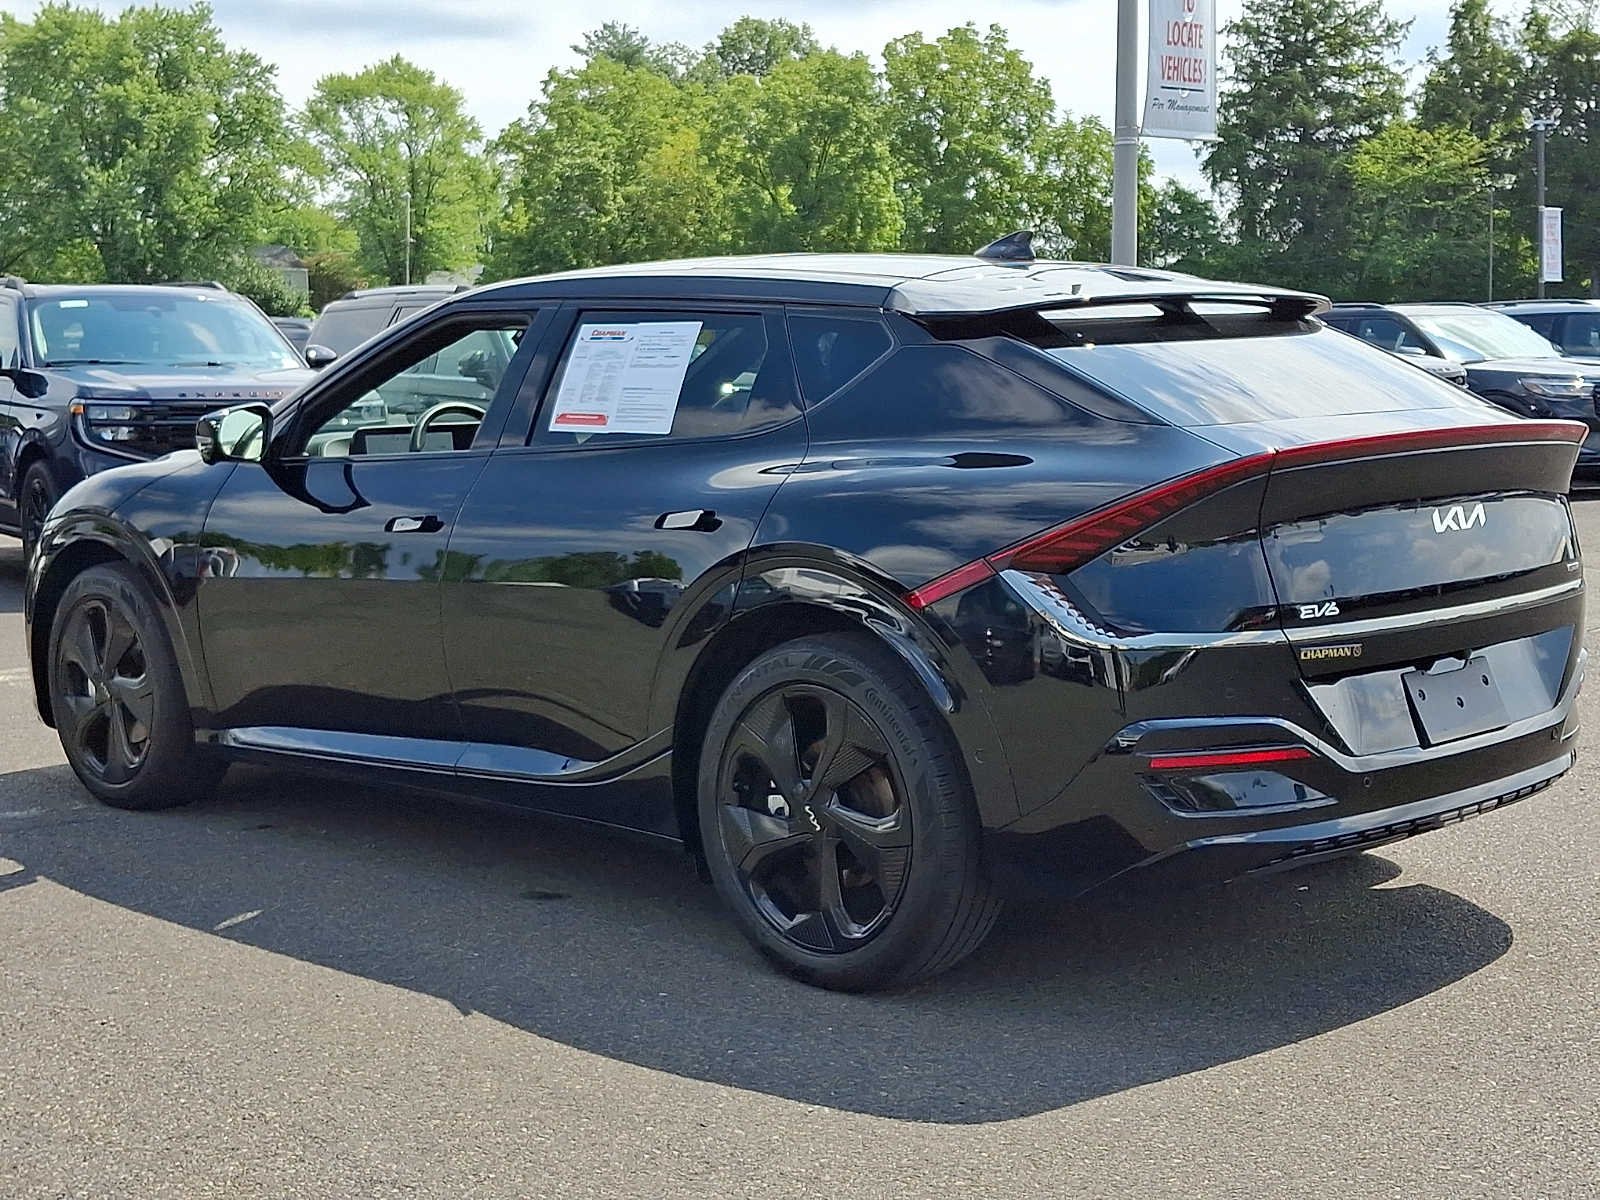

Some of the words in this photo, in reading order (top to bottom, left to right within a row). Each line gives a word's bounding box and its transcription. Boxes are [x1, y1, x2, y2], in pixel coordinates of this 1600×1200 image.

[1166, 21, 1204, 49] LOCATE
[1160, 55, 1207, 84] VEHICLES!
[1151, 97, 1165, 111] Per
[1167, 98, 1210, 115] Management
[1432, 503, 1487, 534] KIA
[1299, 601, 1340, 620] EV6
[1300, 647, 1352, 660] CHAPMAN
